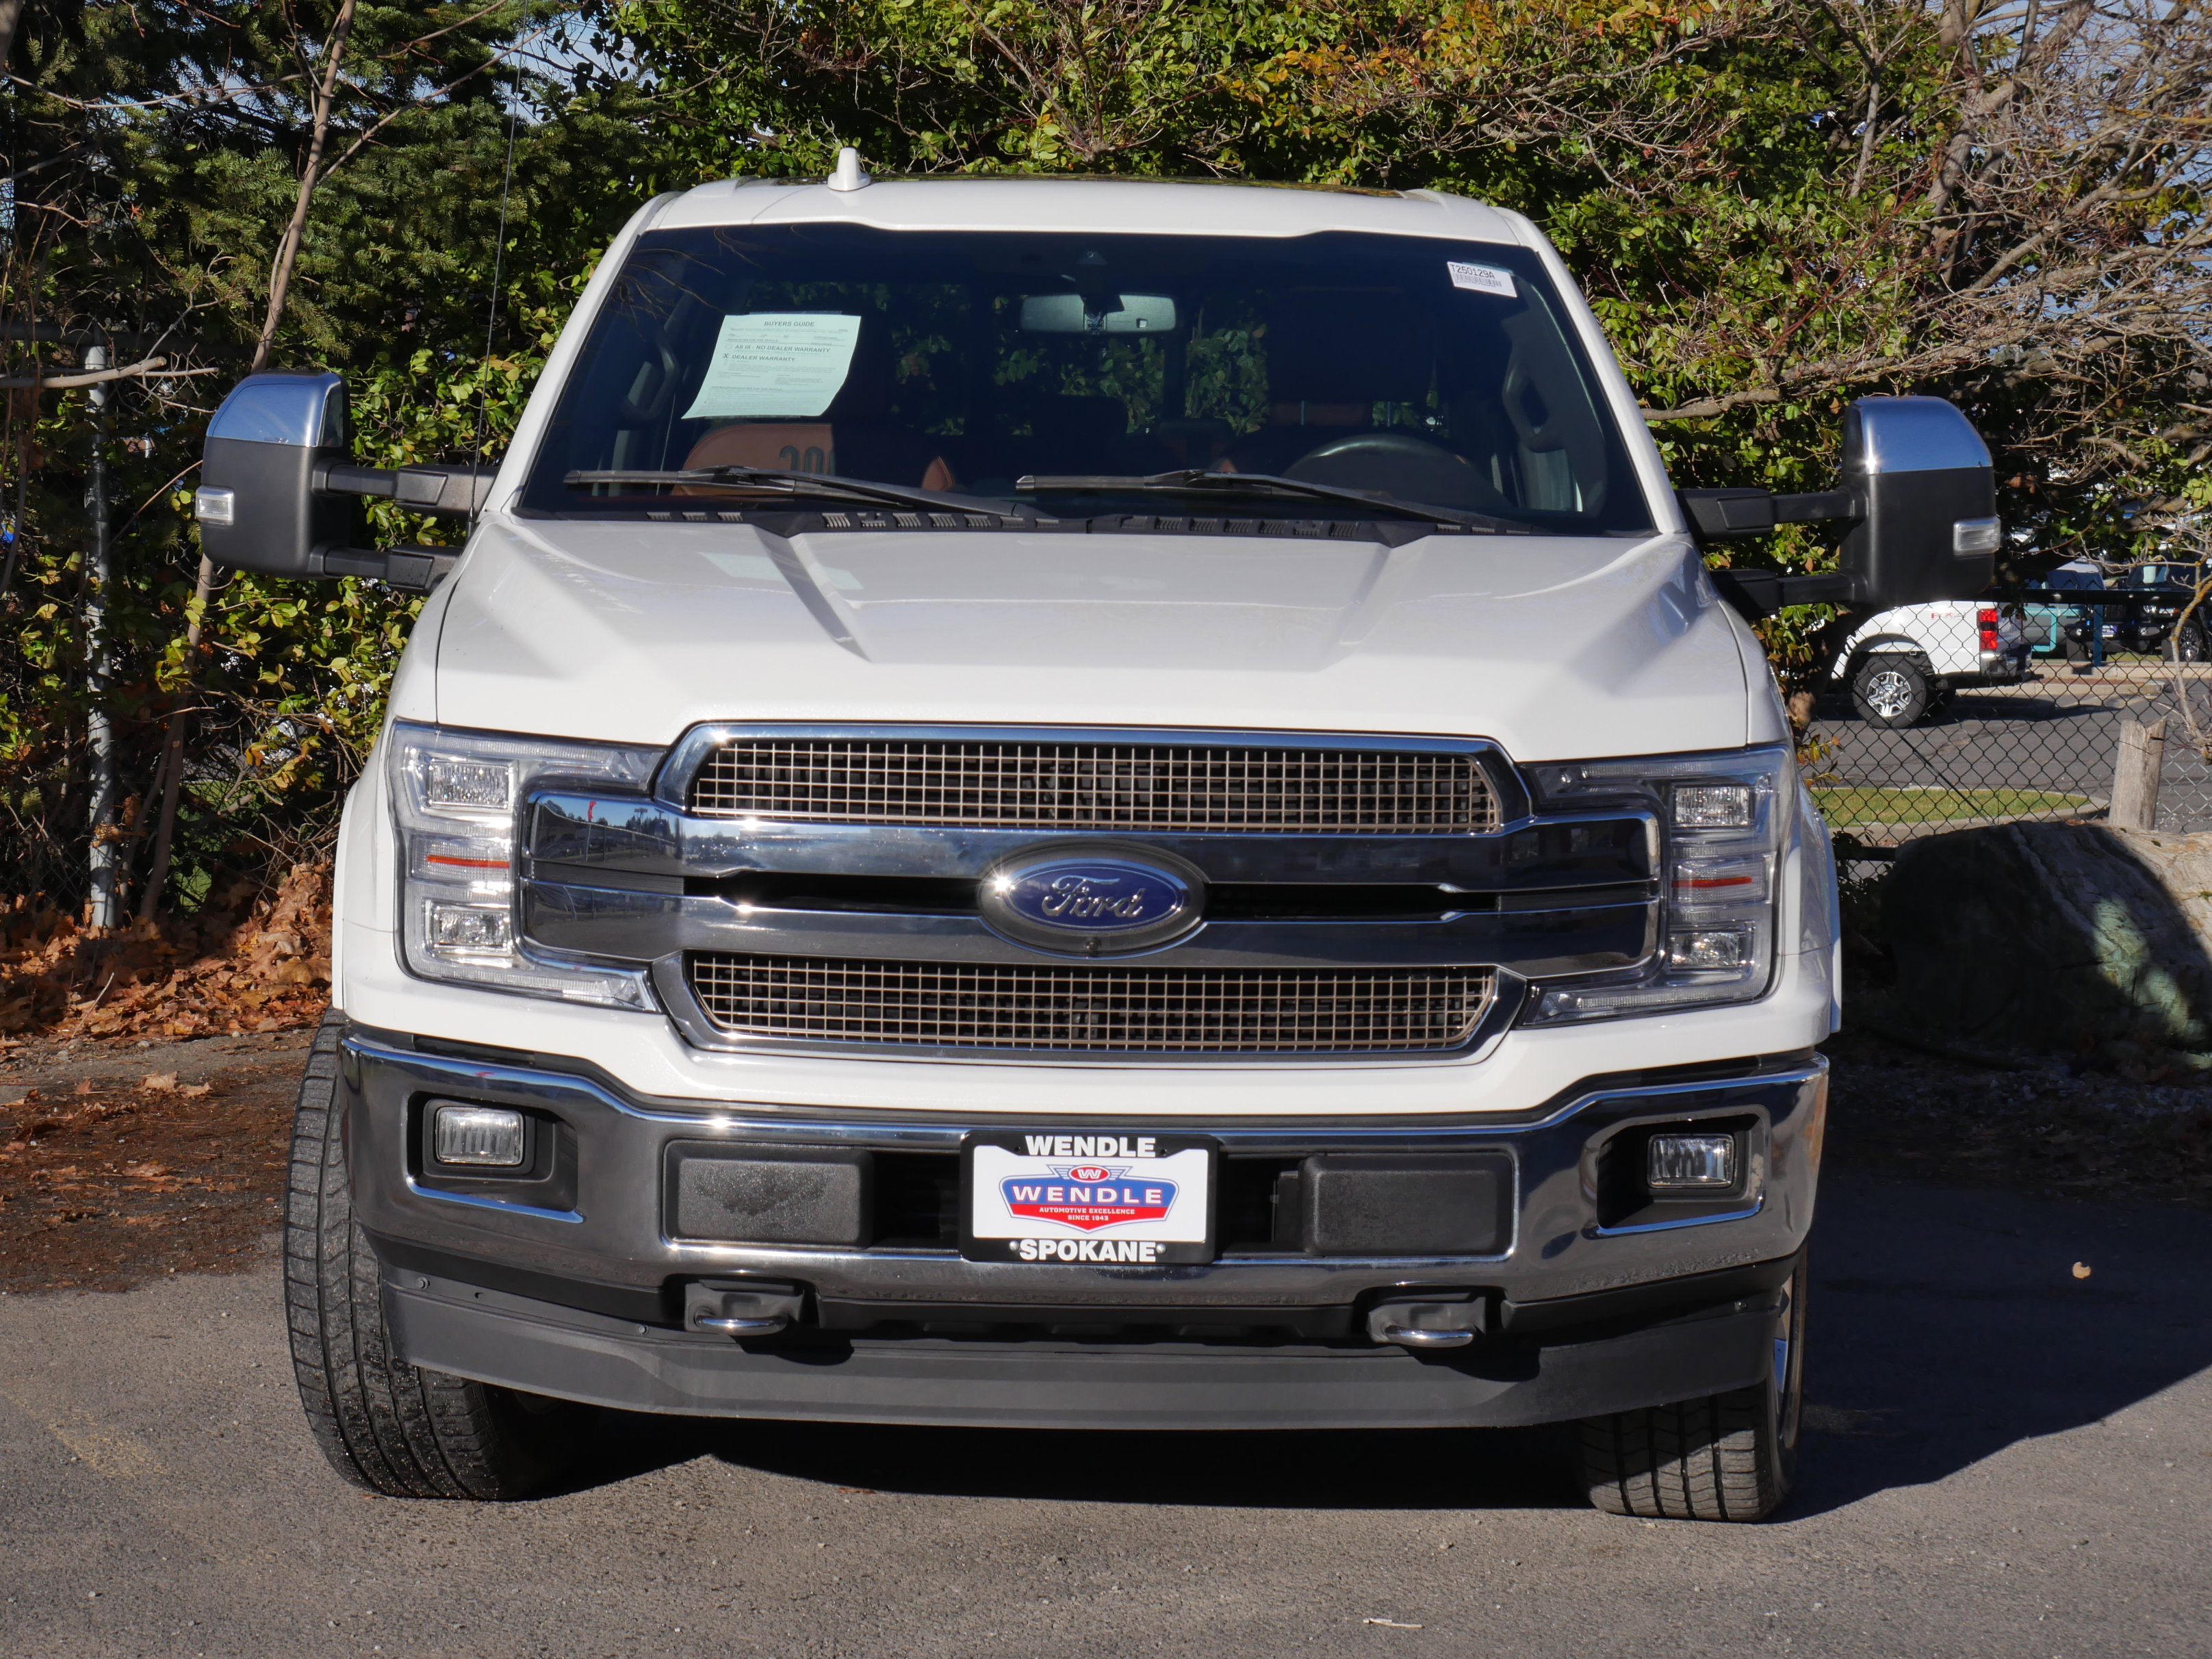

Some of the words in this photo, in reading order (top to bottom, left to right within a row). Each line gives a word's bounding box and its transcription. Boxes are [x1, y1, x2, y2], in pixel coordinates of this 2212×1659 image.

[1450, 264, 1495, 279] T250129A
[1041, 875, 1146, 917] Ford
[1025, 1135, 1156, 1158] WENDLE
[1077, 1168, 1101, 1180] W
[1012, 1185, 1162, 1205] WENDLE
[1019, 1239, 1157, 1262] SPOKANE
